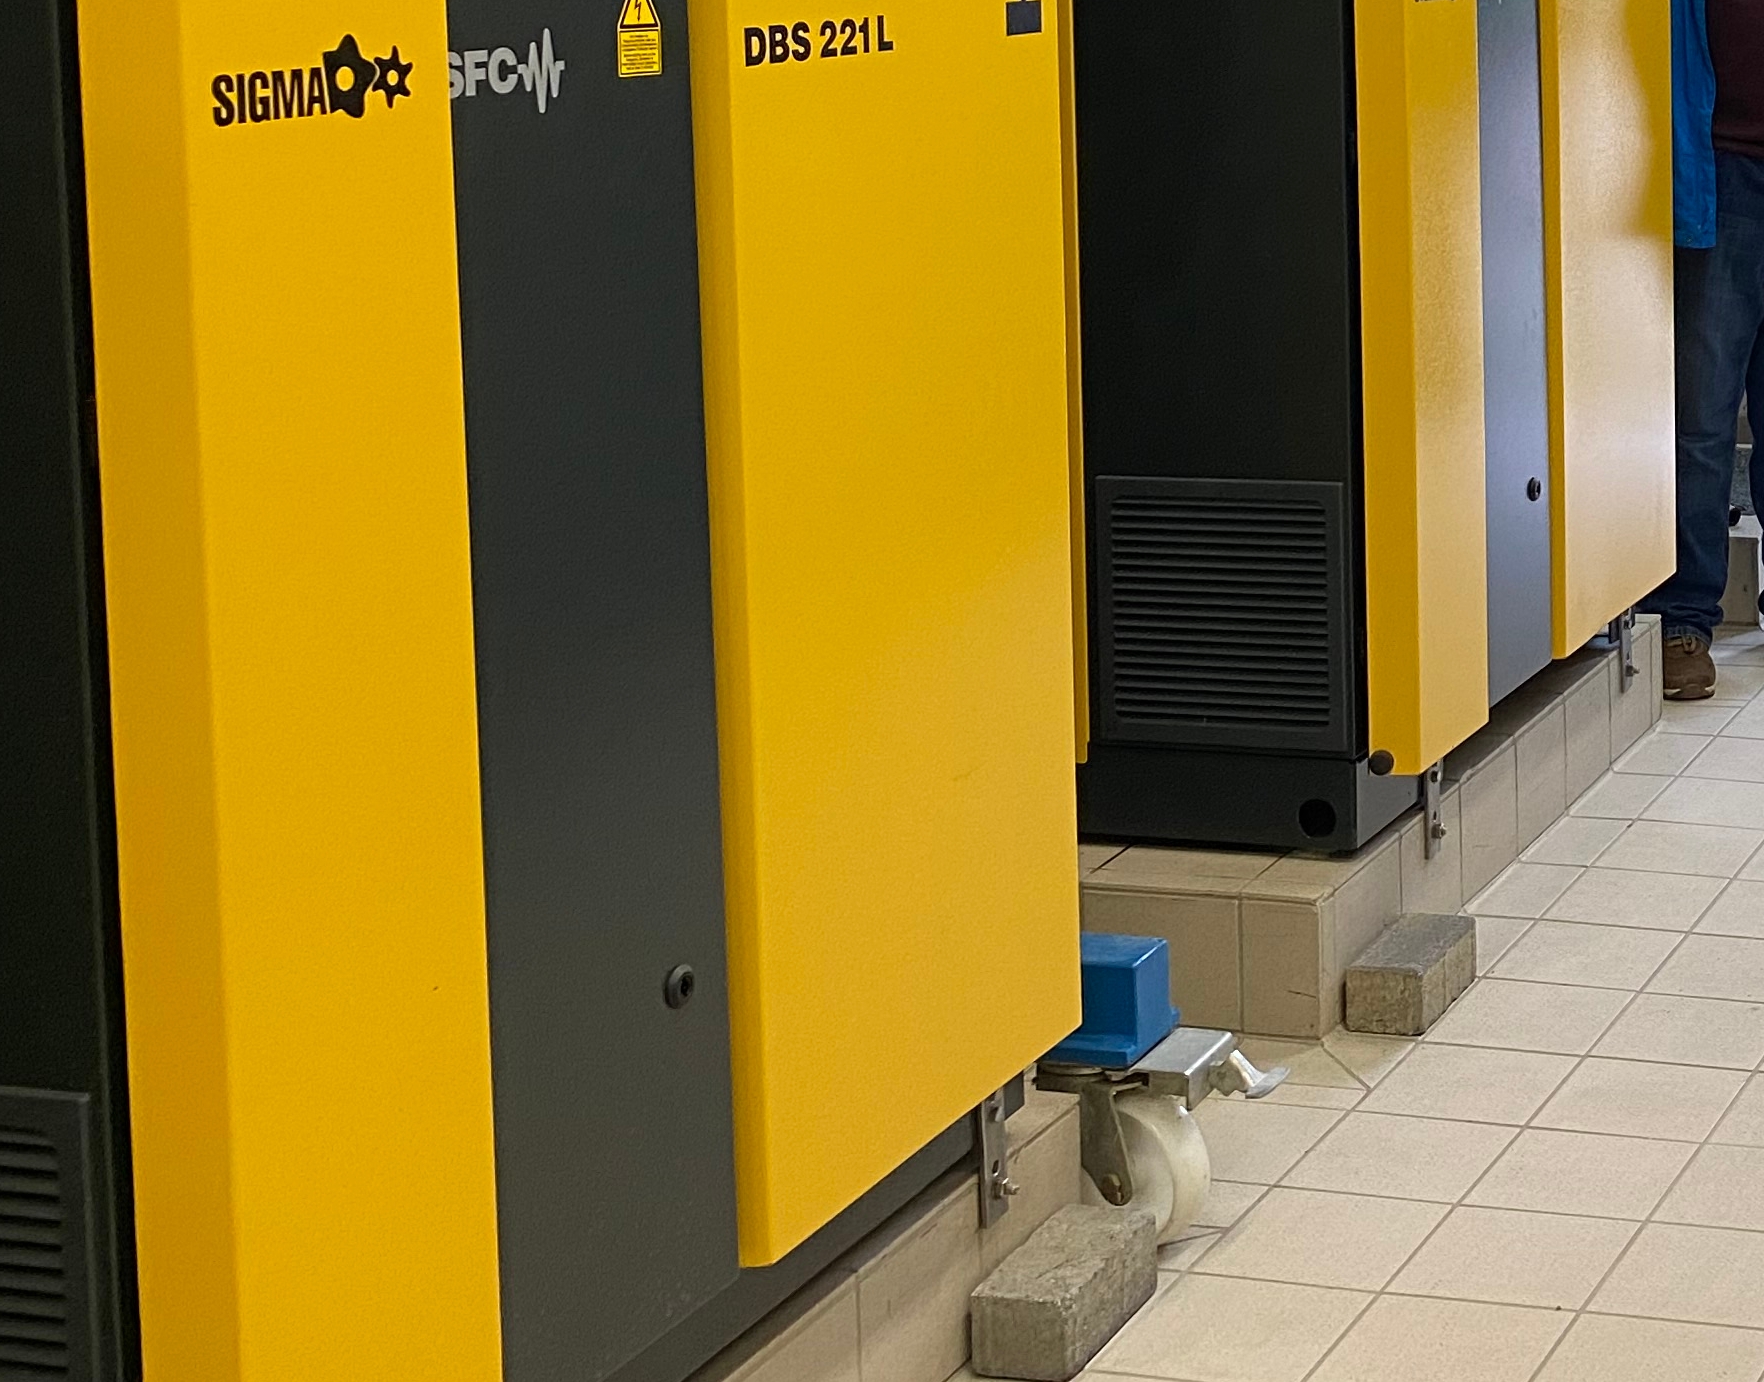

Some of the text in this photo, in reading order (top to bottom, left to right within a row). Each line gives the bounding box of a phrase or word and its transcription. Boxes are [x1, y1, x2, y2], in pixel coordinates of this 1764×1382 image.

[743, 14, 894, 68] DBS 221 L
[210, 66, 328, 128] SIGMA
